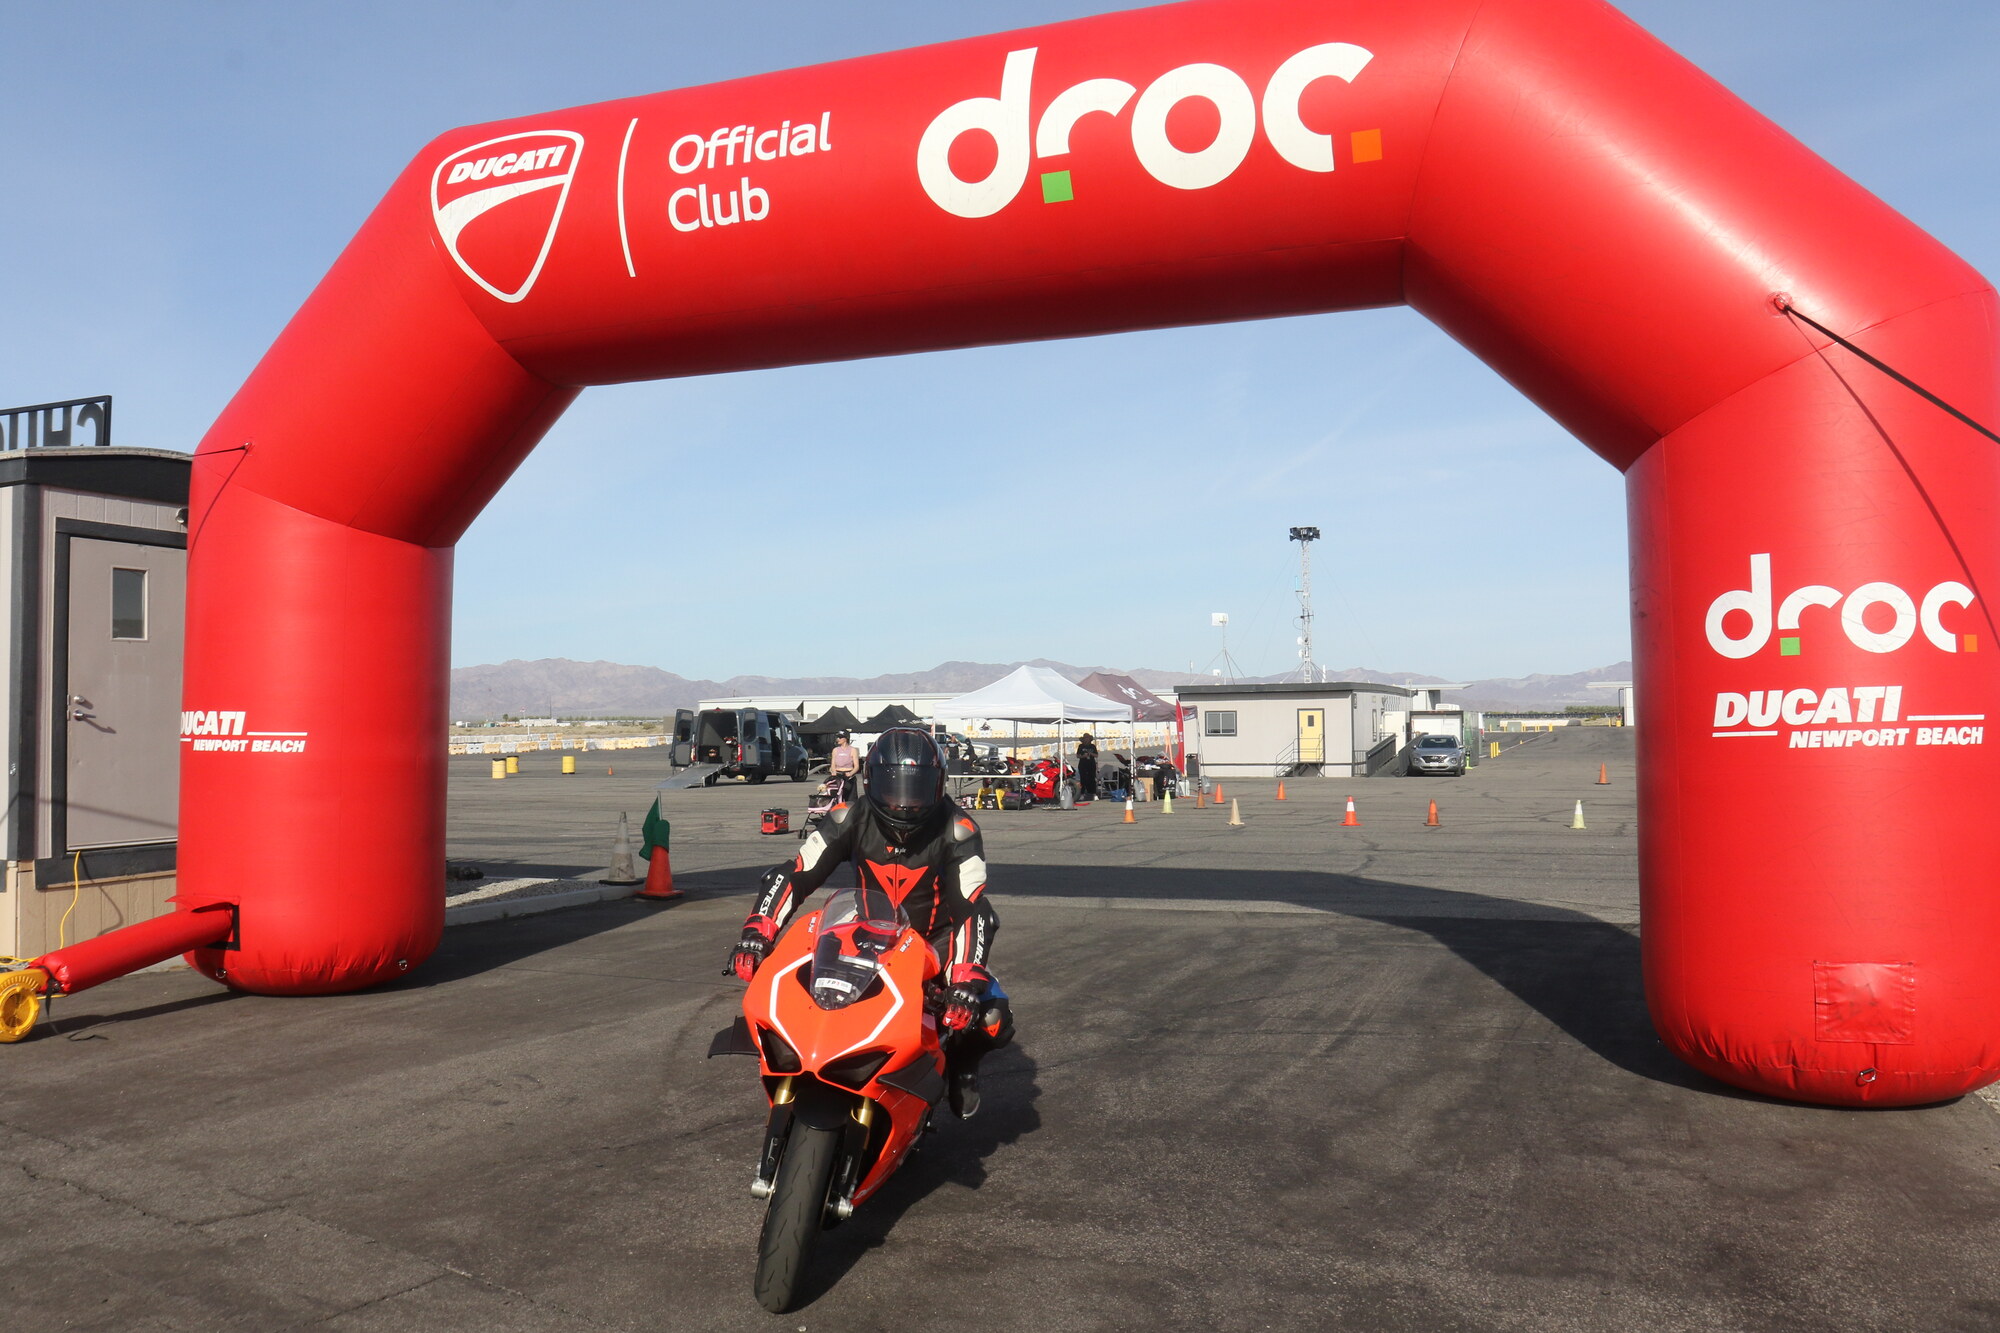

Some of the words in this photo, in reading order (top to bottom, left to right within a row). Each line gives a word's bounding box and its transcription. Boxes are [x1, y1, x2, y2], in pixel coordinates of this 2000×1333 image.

[668, 111, 832, 175] Official
[446, 145, 568, 185] DUCATI
[668, 176, 770, 233] Club
[1713, 685, 1903, 728] DUCATI
[192, 739, 250, 752] NEWPORT
[251, 740, 307, 753] BEACH
[1788, 727, 1911, 749] NEWPORT
[1915, 726, 1985, 746] BEACH
